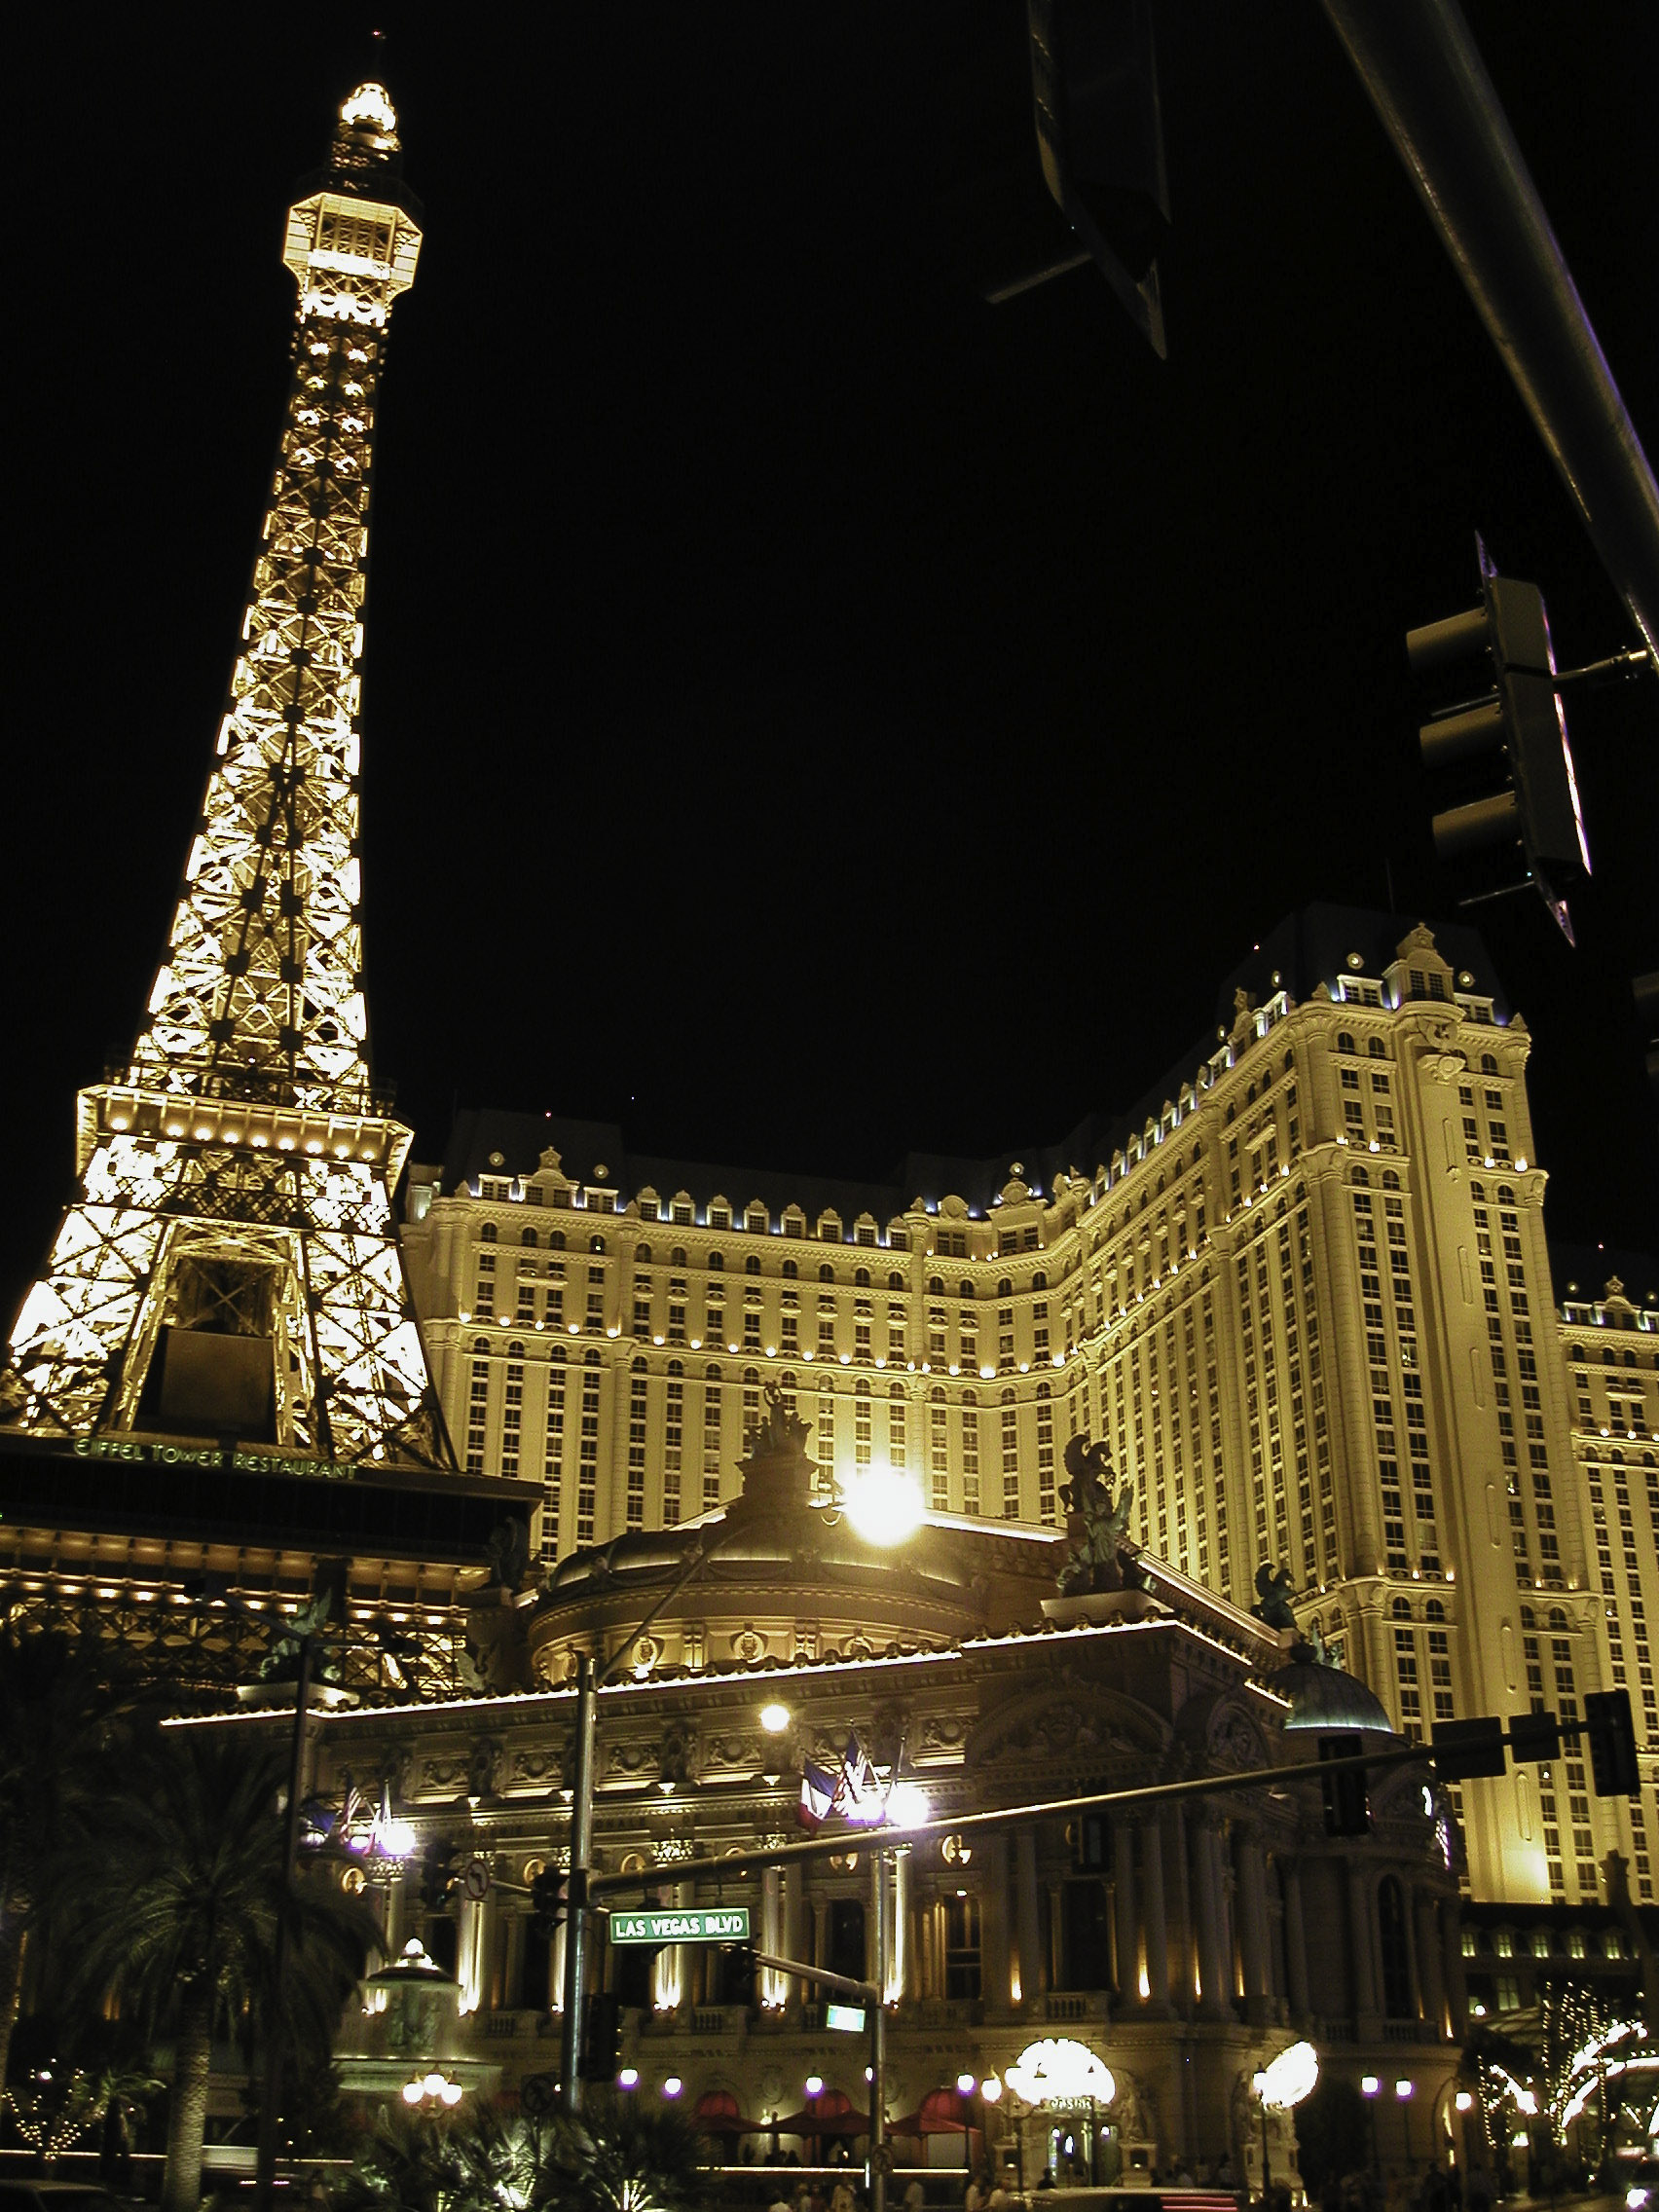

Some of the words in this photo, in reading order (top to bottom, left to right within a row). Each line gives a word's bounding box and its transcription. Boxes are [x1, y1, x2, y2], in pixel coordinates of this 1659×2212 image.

[74, 1438, 145, 1460] EIFFEL
[151, 1443, 223, 1466] TOWER
[233, 1452, 358, 1479] RESTAURANT
[615, 1920, 646, 1937] LAS
[650, 1917, 701, 1936] VEGAS
[705, 1915, 743, 1934] BLVD
